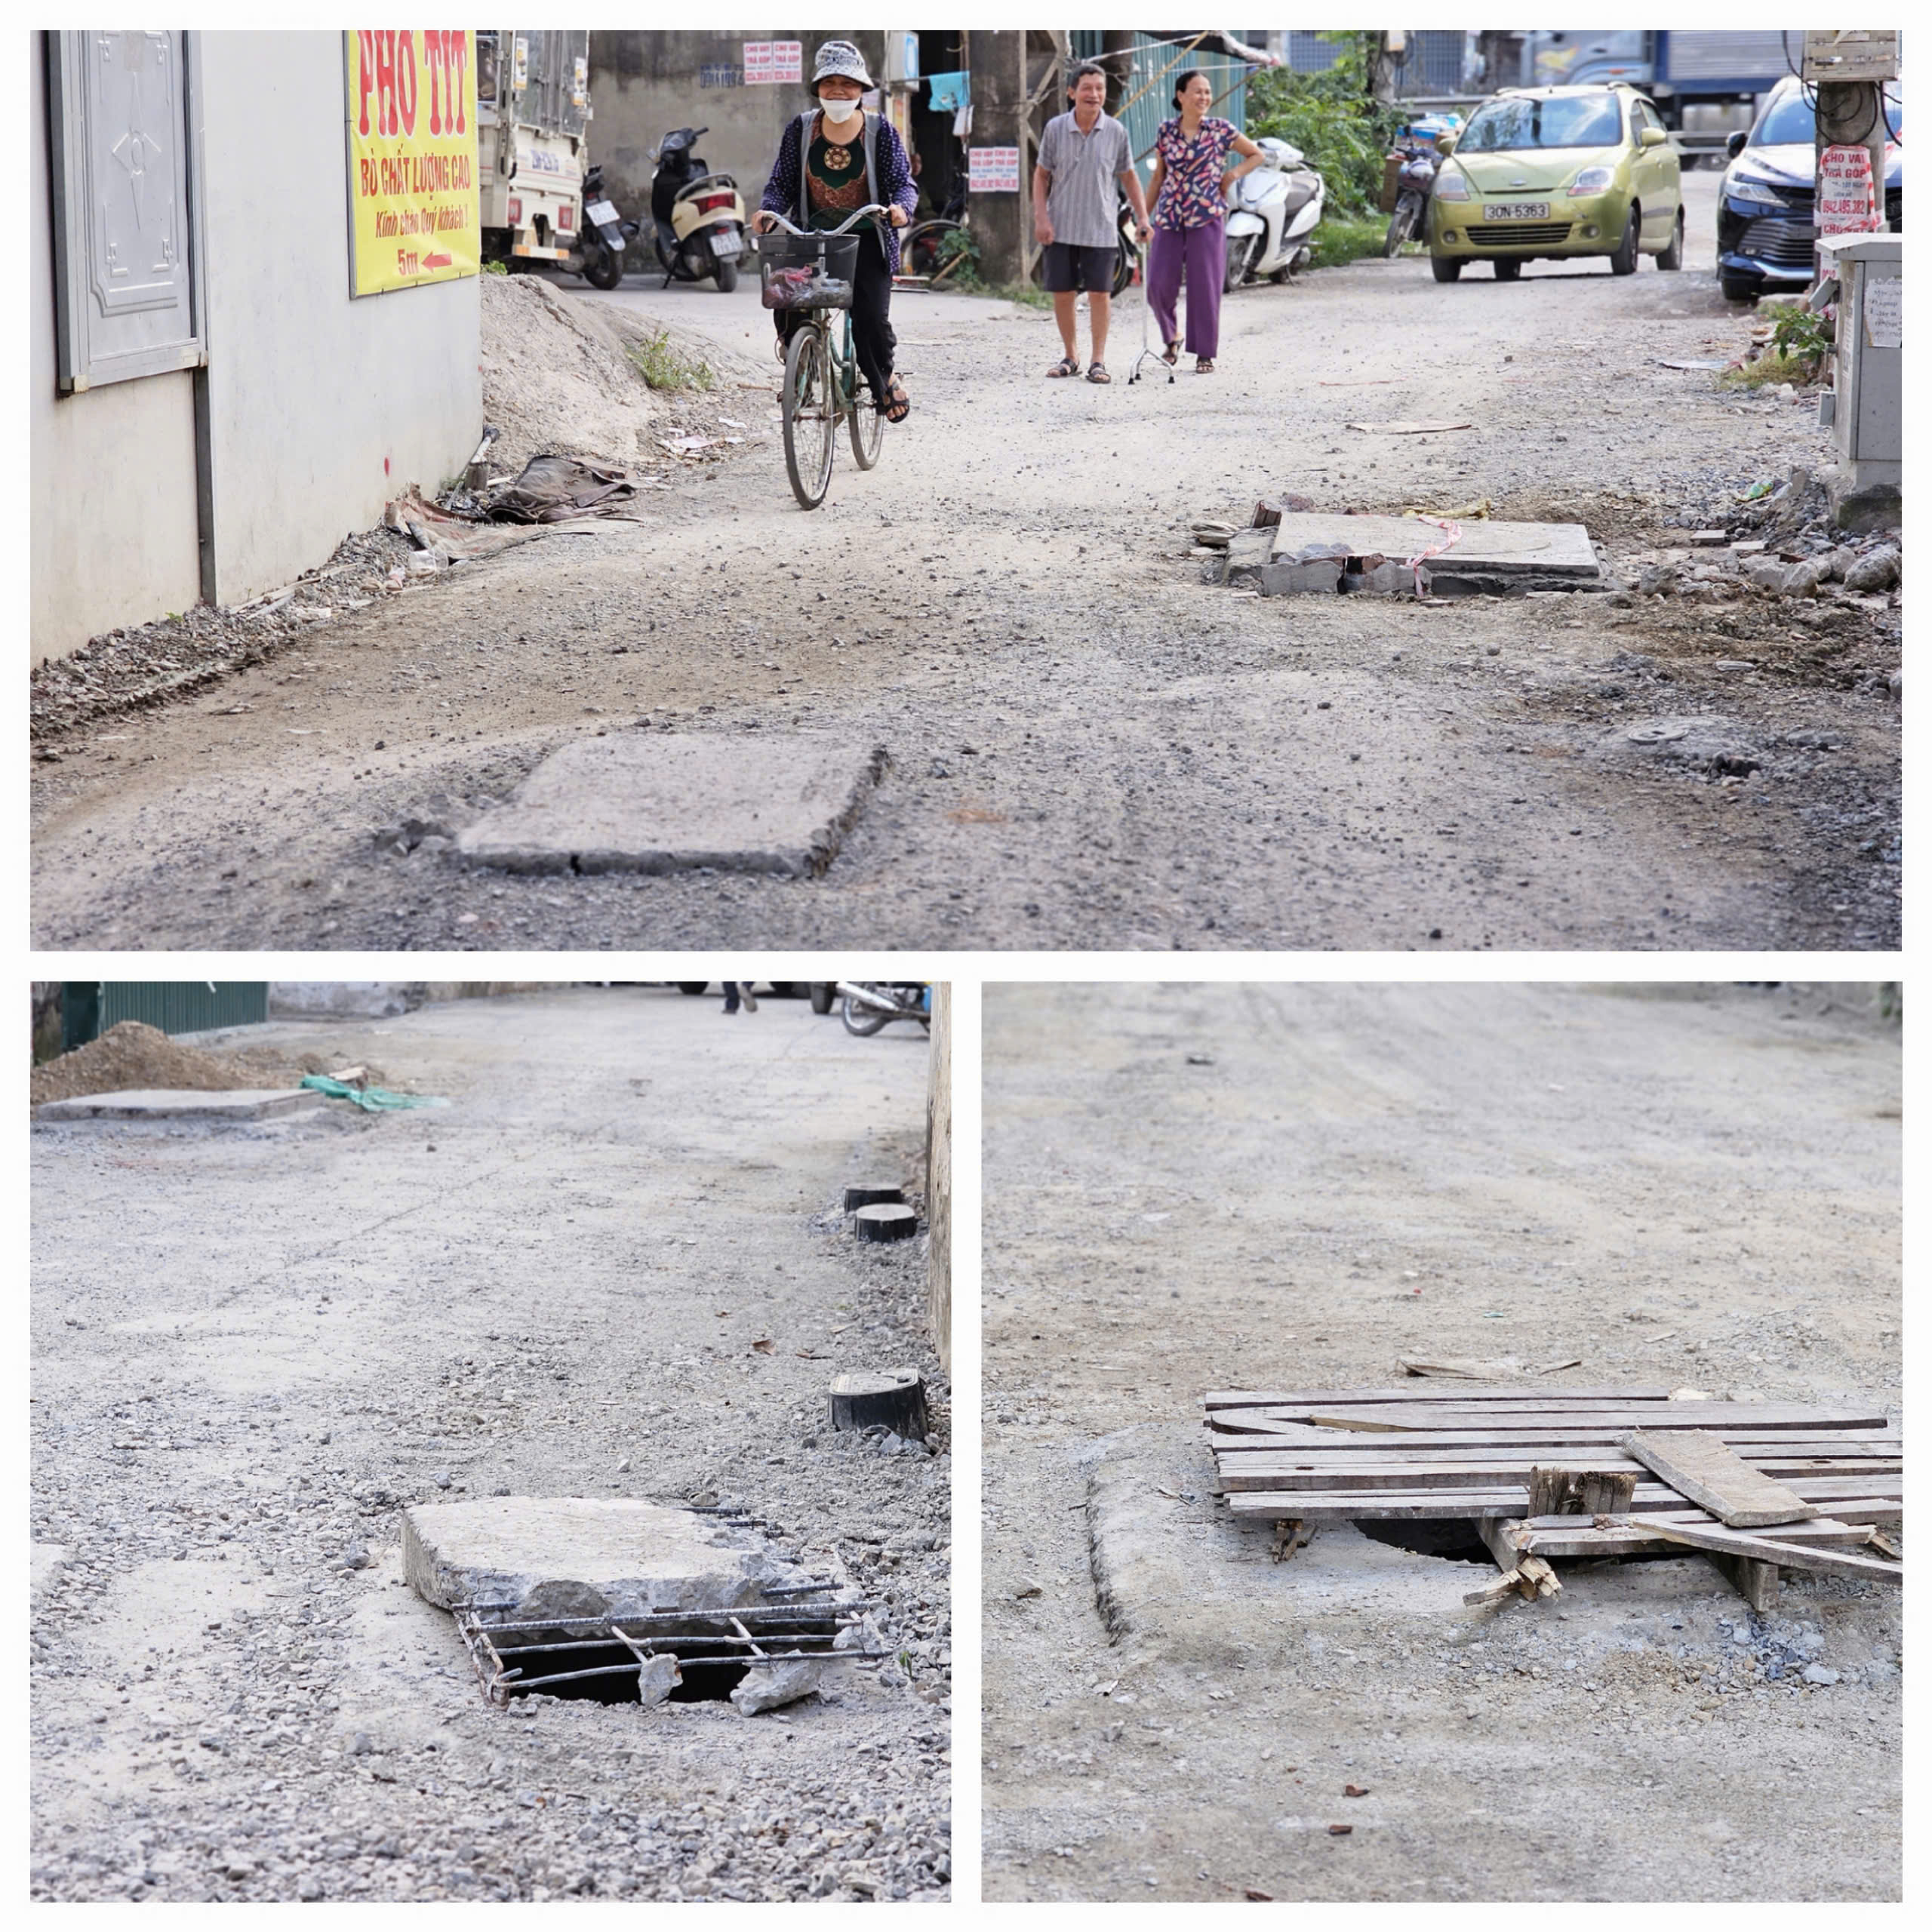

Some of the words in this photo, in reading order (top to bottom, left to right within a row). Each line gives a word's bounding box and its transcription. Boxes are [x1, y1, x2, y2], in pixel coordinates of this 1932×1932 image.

[360, 147, 378, 197] BÒ
[381, 143, 410, 195] CHẤT
[413, 152, 449, 201] LƯỢNG
[451, 154, 471, 191] CAO
[376, 210, 398, 238] Kính
[420, 206, 438, 235] Quý
[438, 204, 463, 232] khách
[1487, 205, 1546, 218] 30N-5363
[397, 248, 419, 276] 5m
